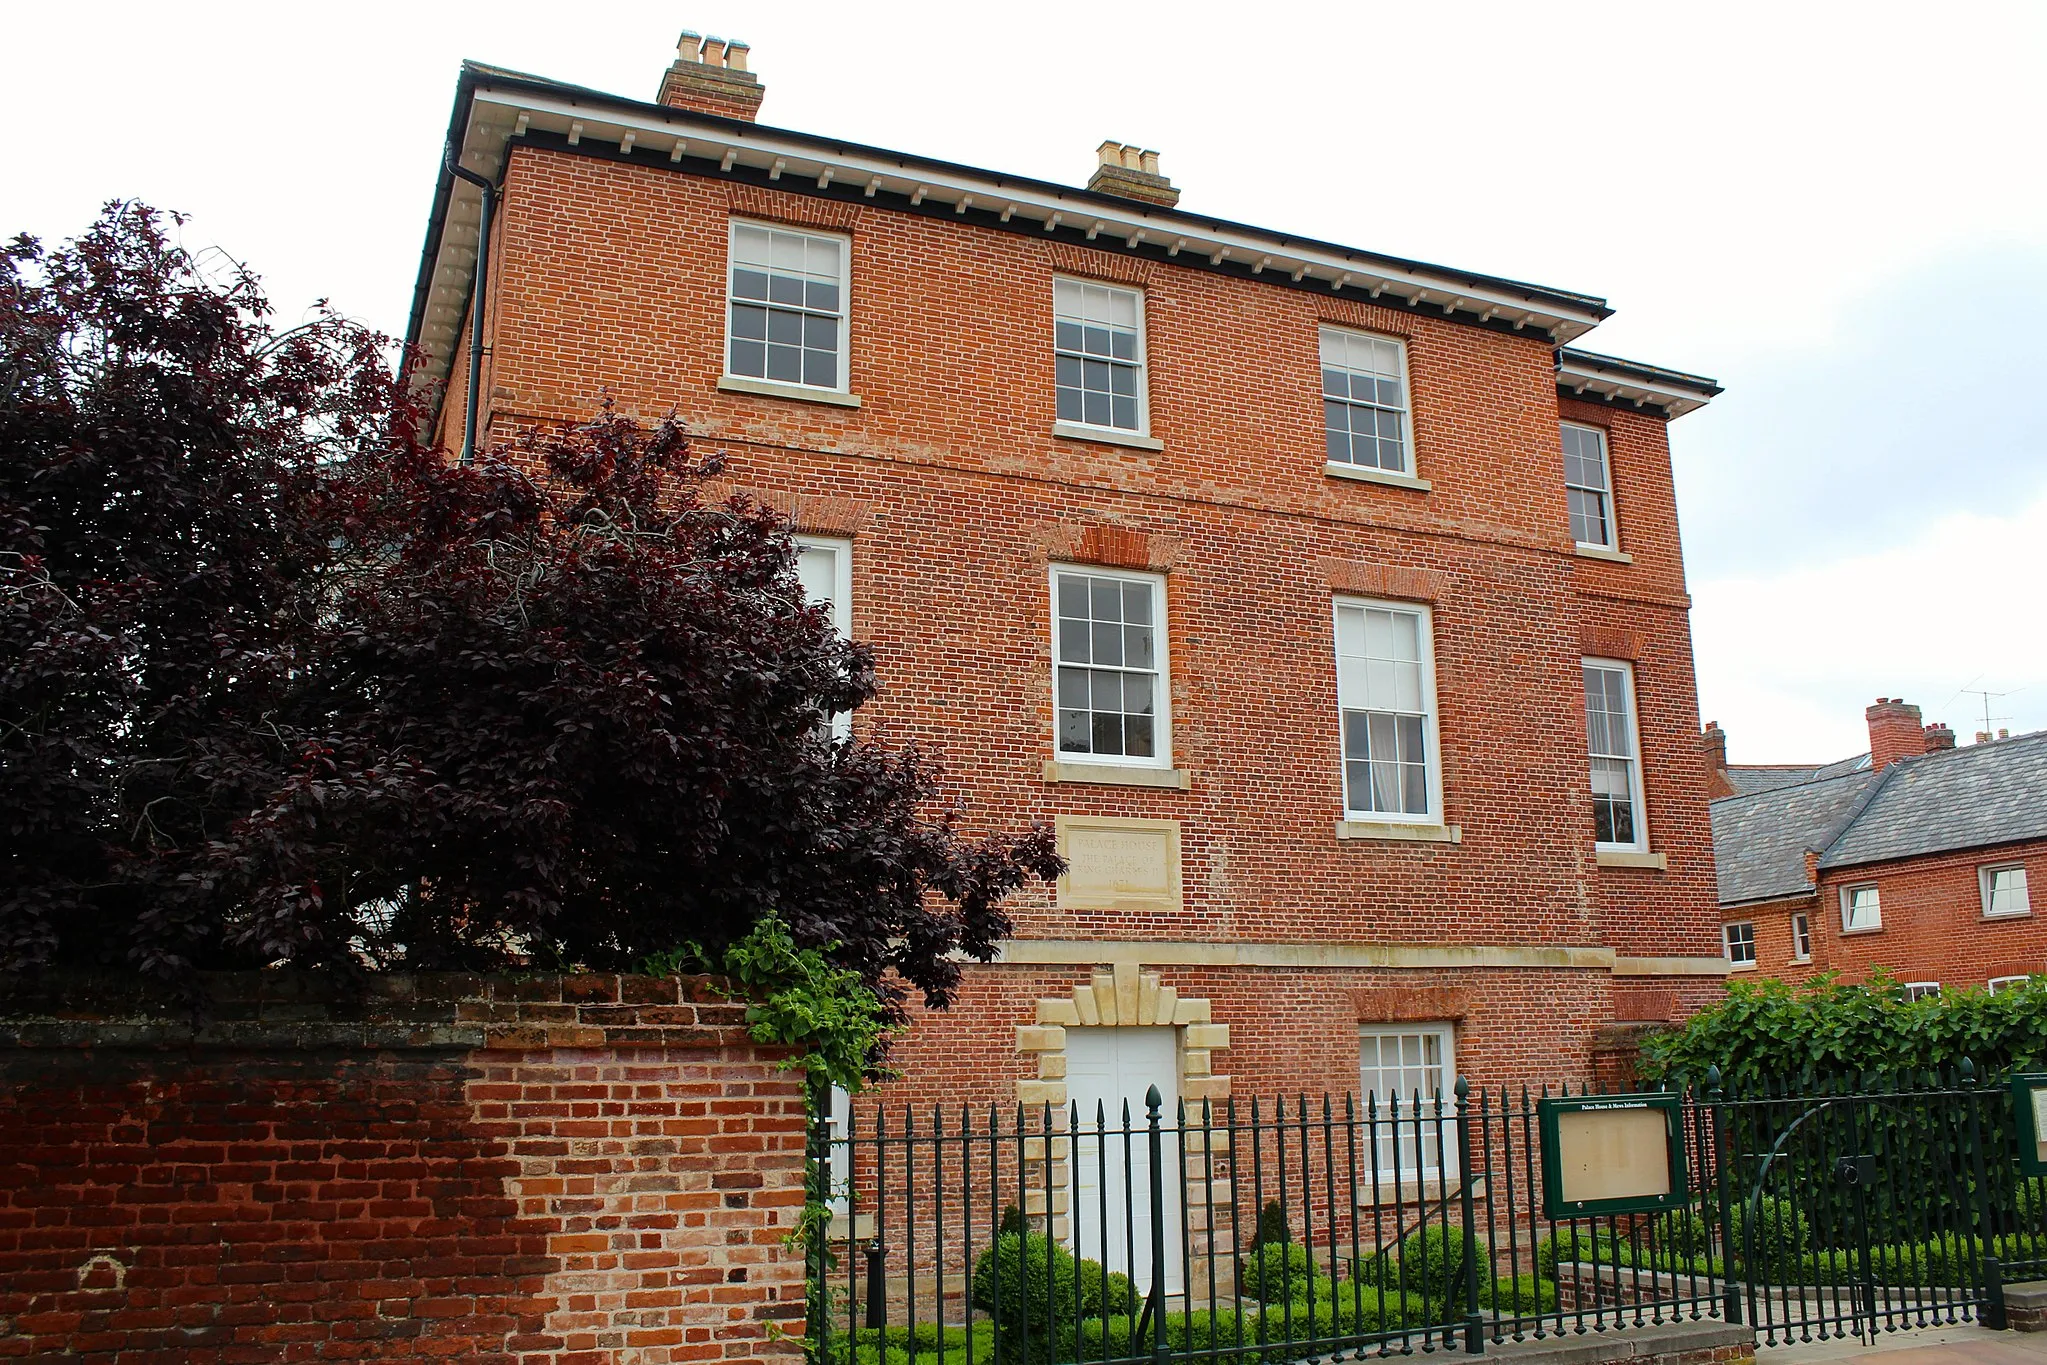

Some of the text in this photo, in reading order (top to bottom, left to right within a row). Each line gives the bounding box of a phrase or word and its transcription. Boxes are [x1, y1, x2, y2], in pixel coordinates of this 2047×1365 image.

[1078, 839, 1158, 851] PALACE HOUSE
[1082, 854, 1098, 863] THE
